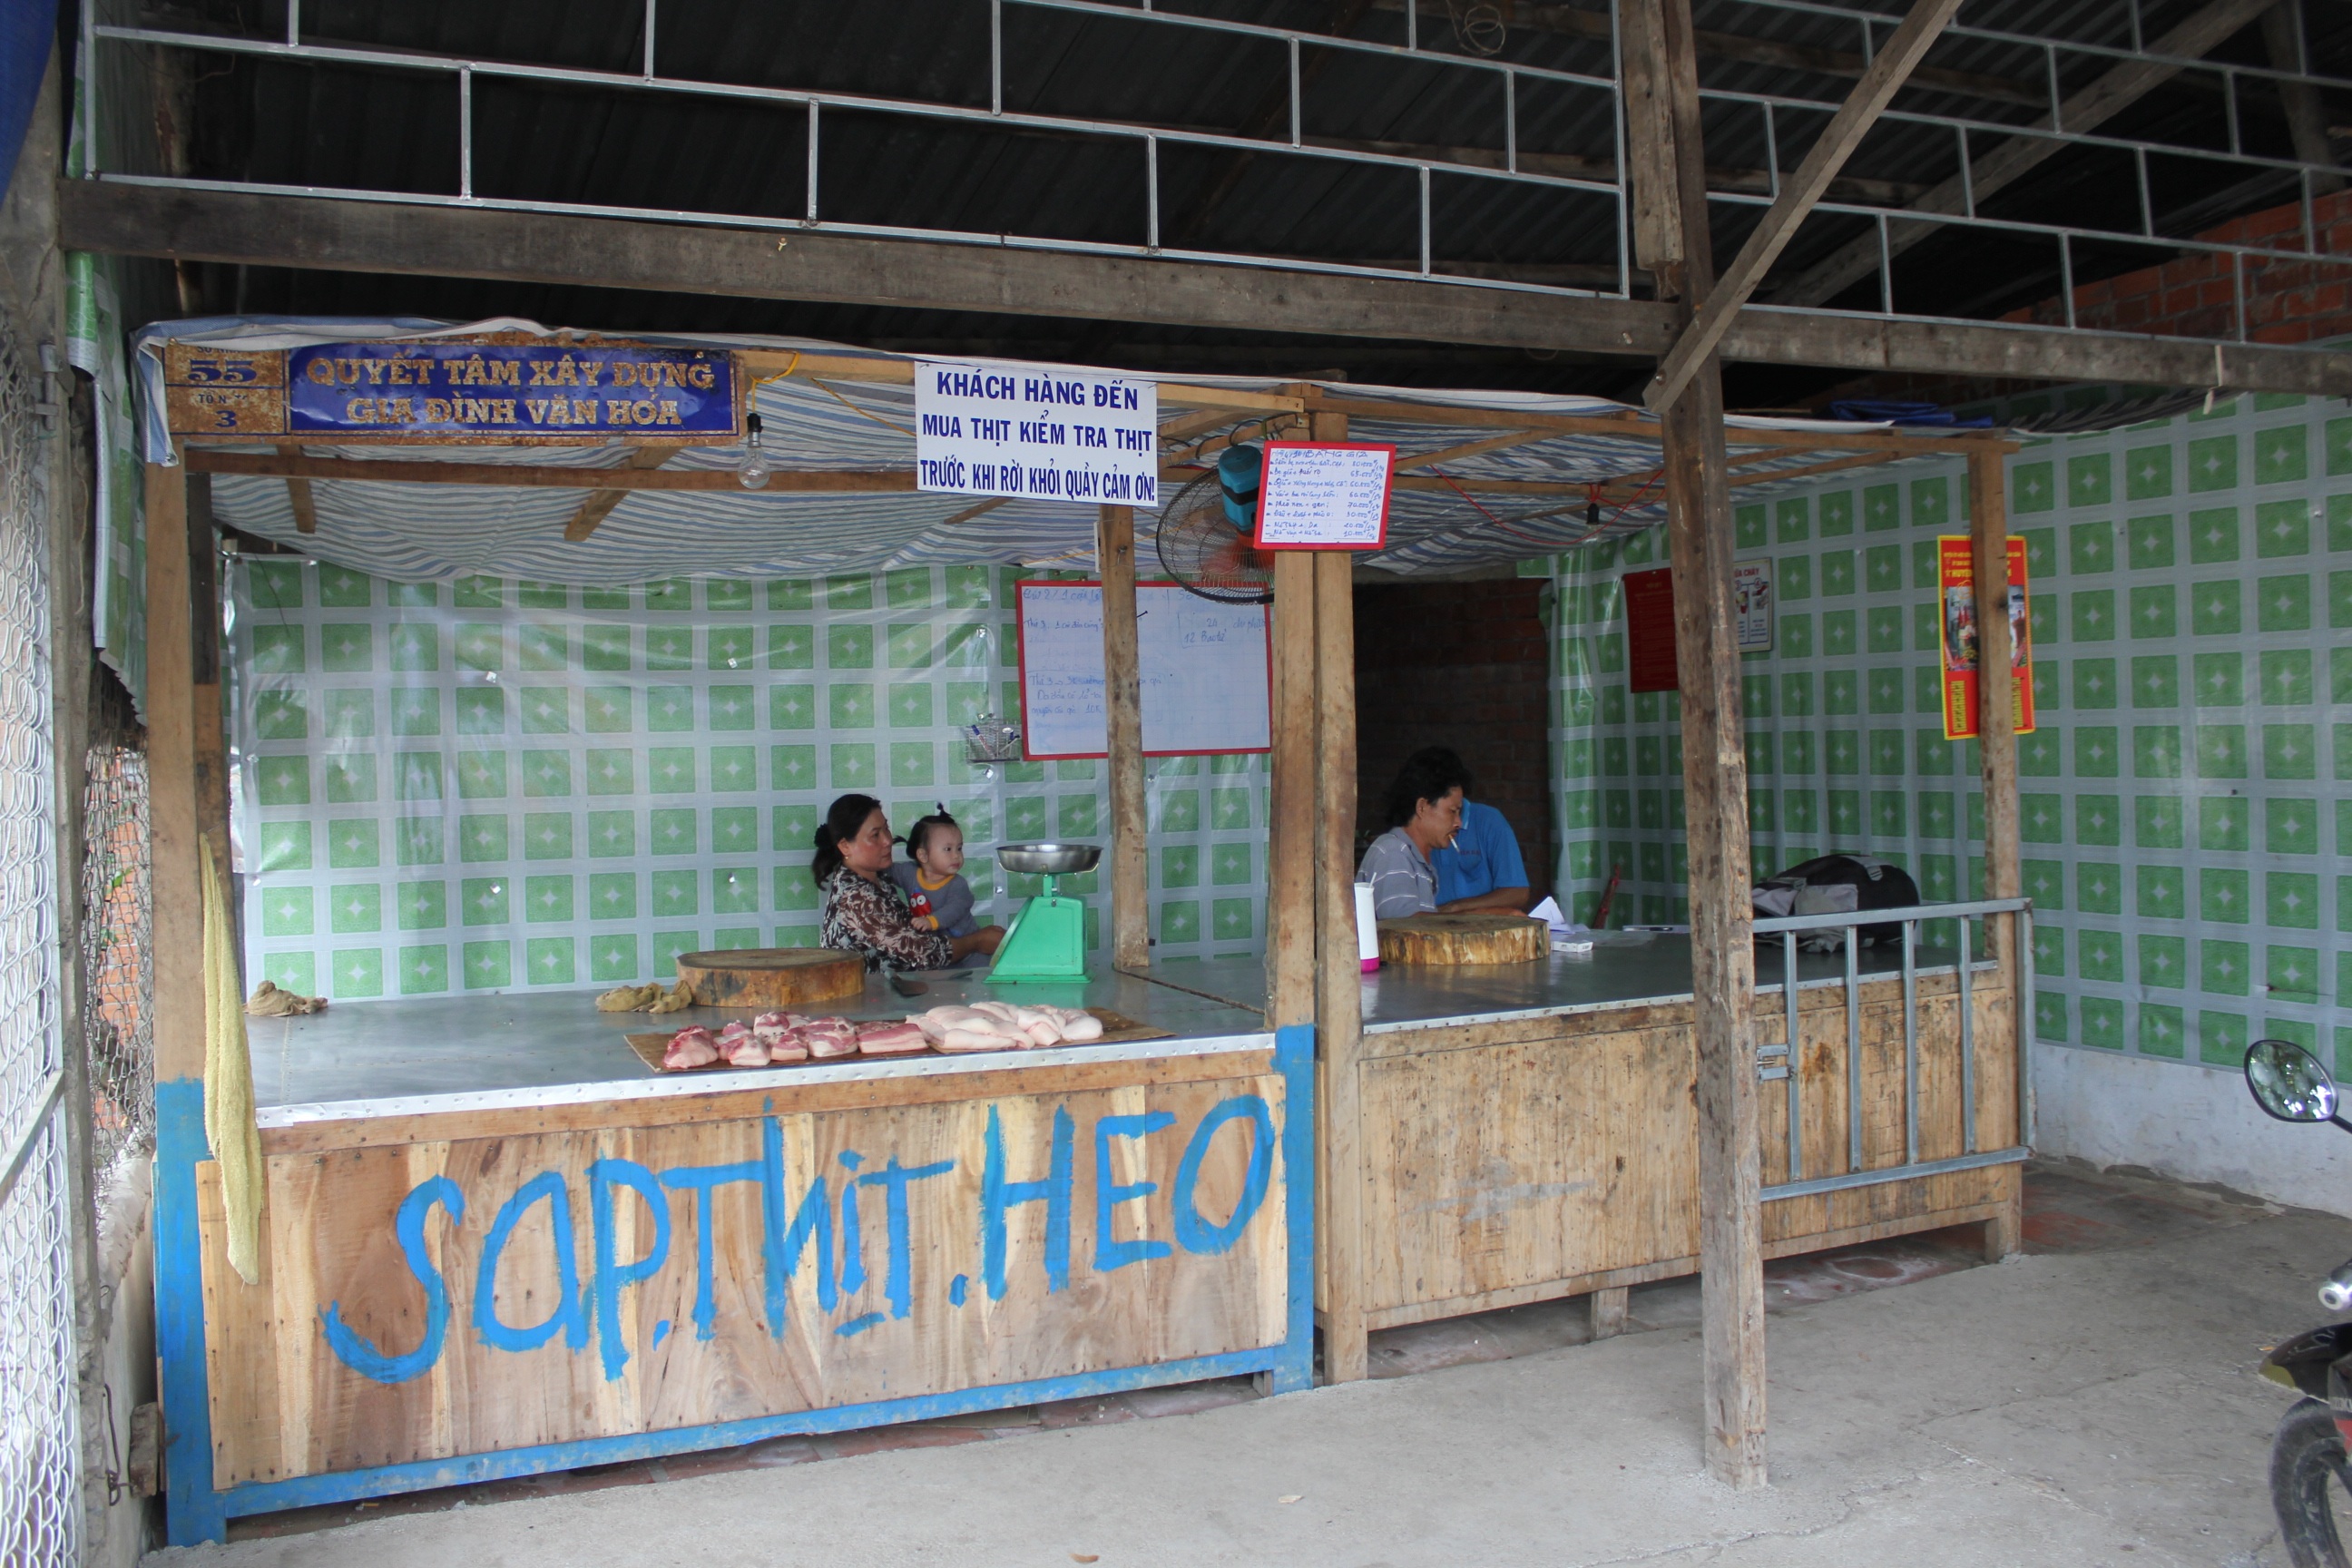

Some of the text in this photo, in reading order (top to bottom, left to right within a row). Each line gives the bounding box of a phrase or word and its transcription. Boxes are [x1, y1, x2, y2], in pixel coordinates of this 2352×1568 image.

[187, 358, 257, 382] 55
[307, 348, 715, 392] QUYẾT TÂM XÂY DỰNG
[936, 368, 1138, 410] KHÁCH HÀNG ĐẾN
[215, 410, 237, 427] 3
[346, 390, 682, 426] GIA ĐÌNH VĂN HÓA
[923, 409, 1152, 456] MUA THỊT KIỂM TRA THỊT
[920, 454, 1155, 502] TRƯỚC KHI RỜI KHỎI QUẦY CẢM ƠN!
[981, 1095, 1276, 1300] HEO
